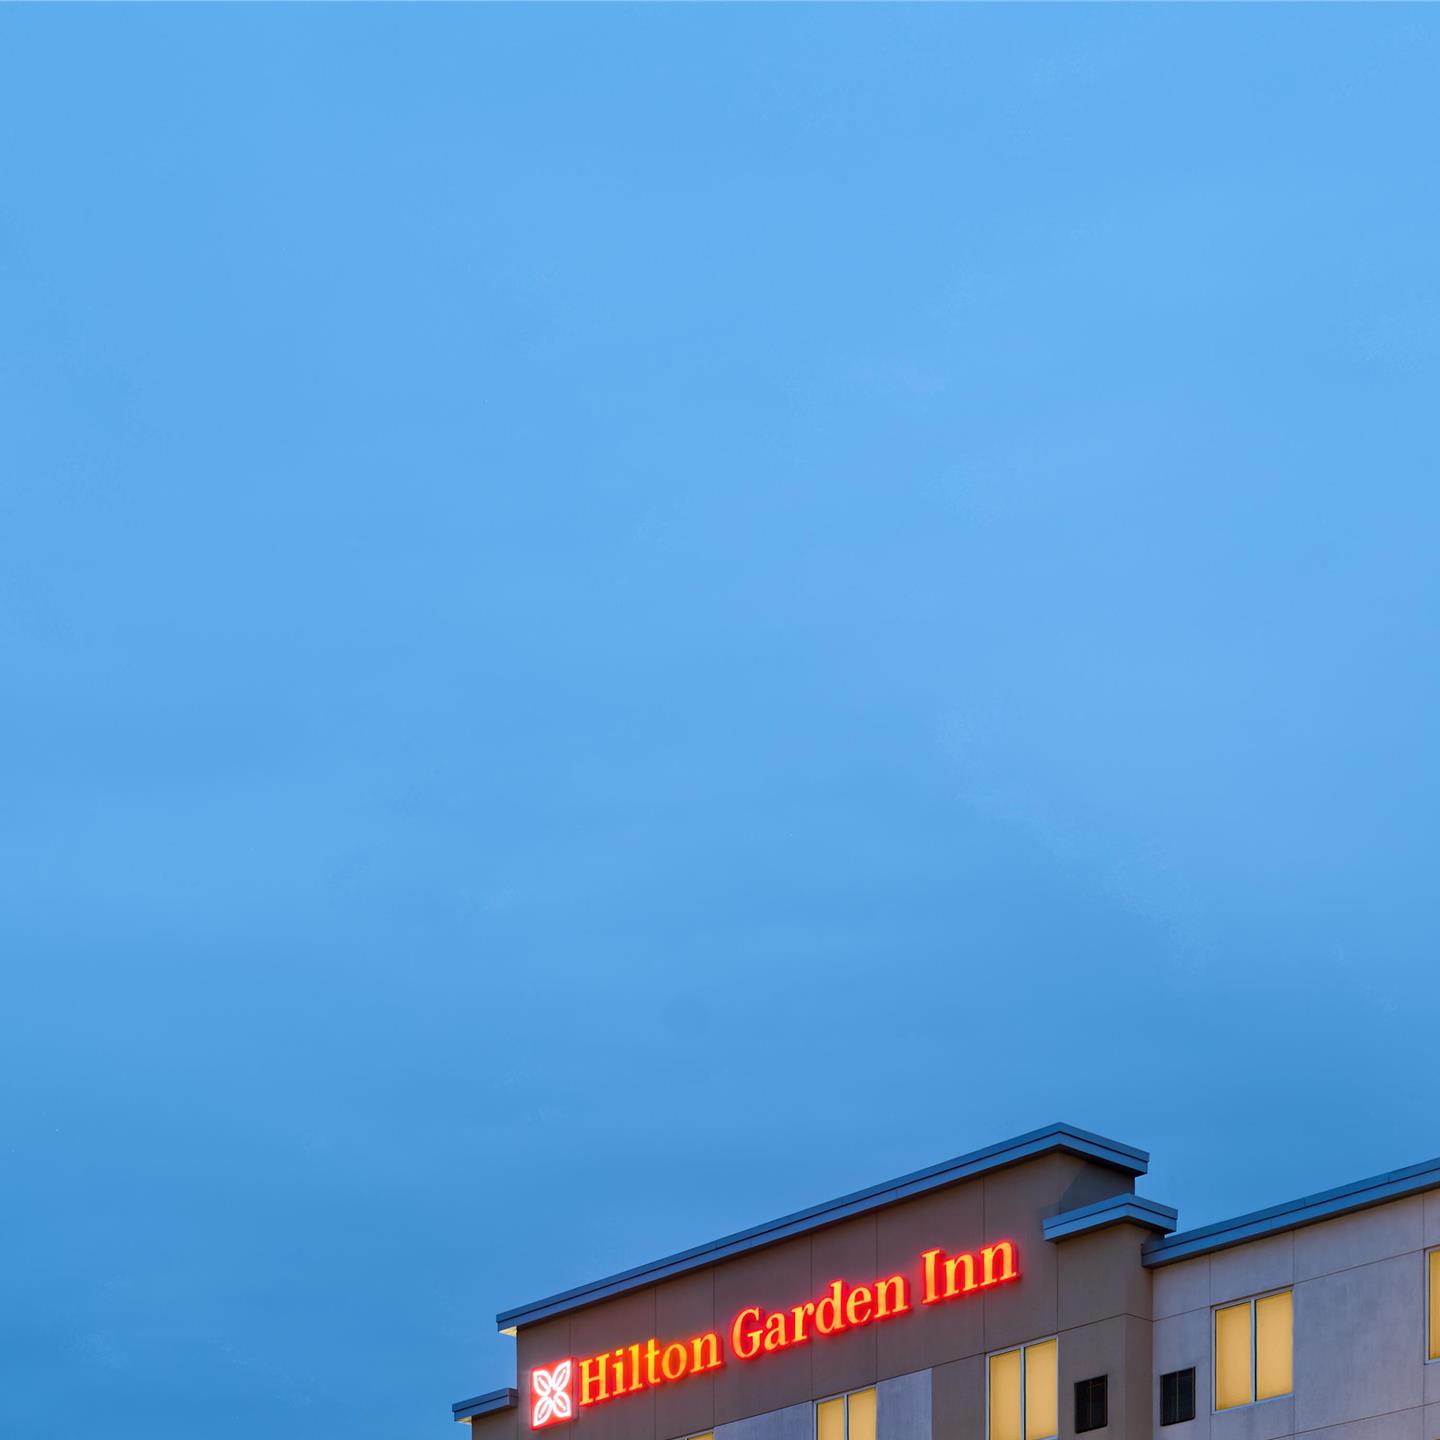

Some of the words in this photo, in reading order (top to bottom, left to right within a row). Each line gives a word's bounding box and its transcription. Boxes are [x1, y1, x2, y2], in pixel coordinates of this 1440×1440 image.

[577, 1331, 723, 1407] Hilton
[730, 1273, 910, 1360] Garden
[920, 1240, 1018, 1305] Inn
